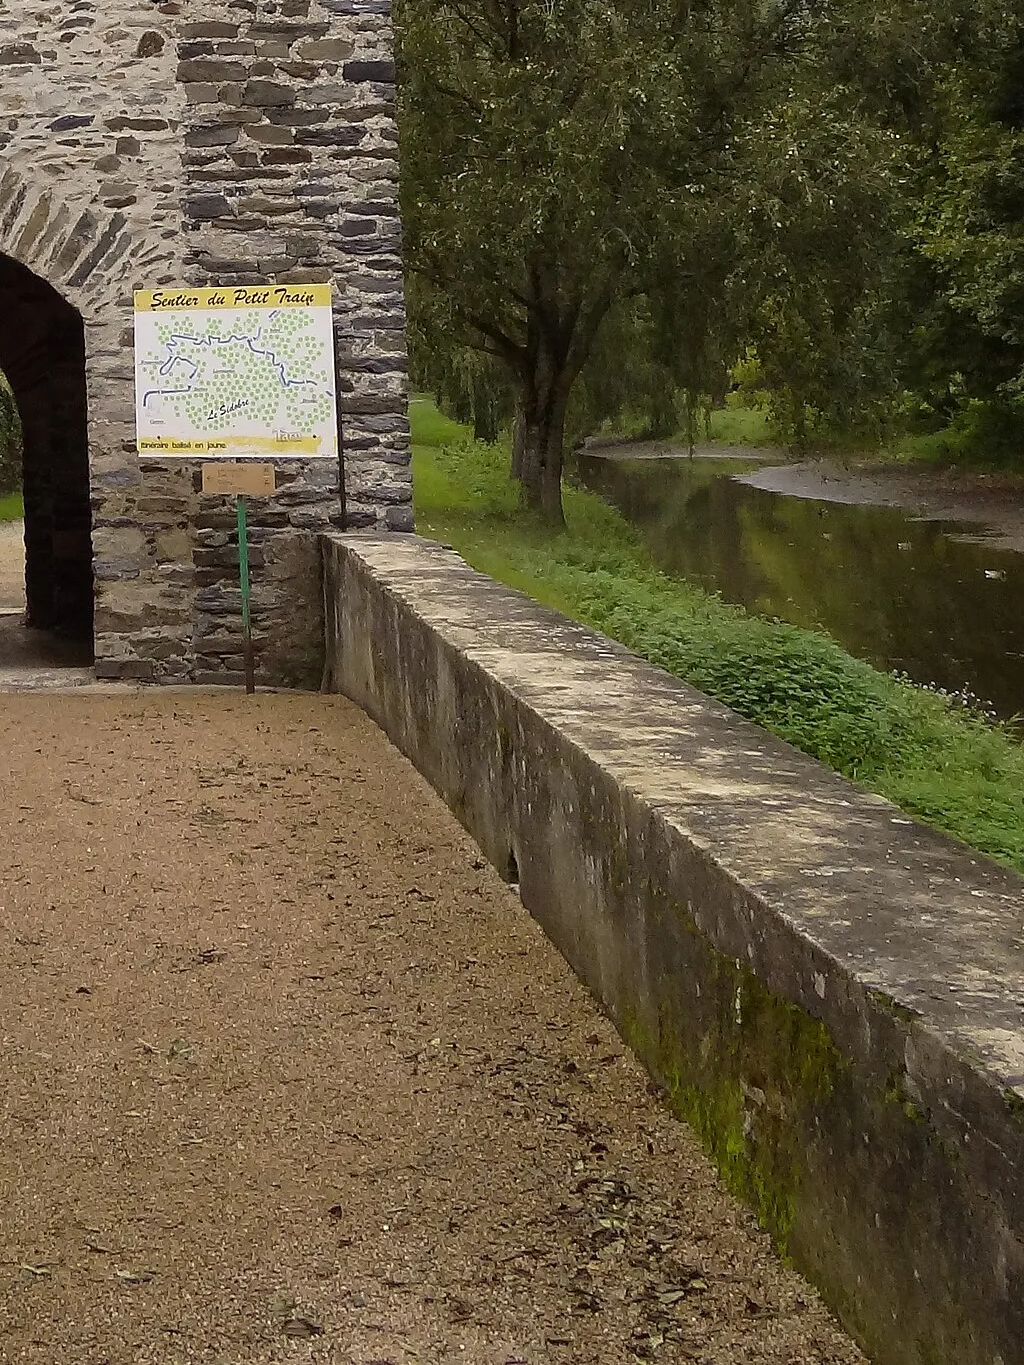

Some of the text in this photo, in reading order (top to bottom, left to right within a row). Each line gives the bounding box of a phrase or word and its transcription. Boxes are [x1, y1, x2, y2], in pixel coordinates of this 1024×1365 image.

[151, 288, 314, 307] Sentier du Petit Train
[207, 399, 249, 420] Le Sidobre
[172, 441, 191, 449] balisé
